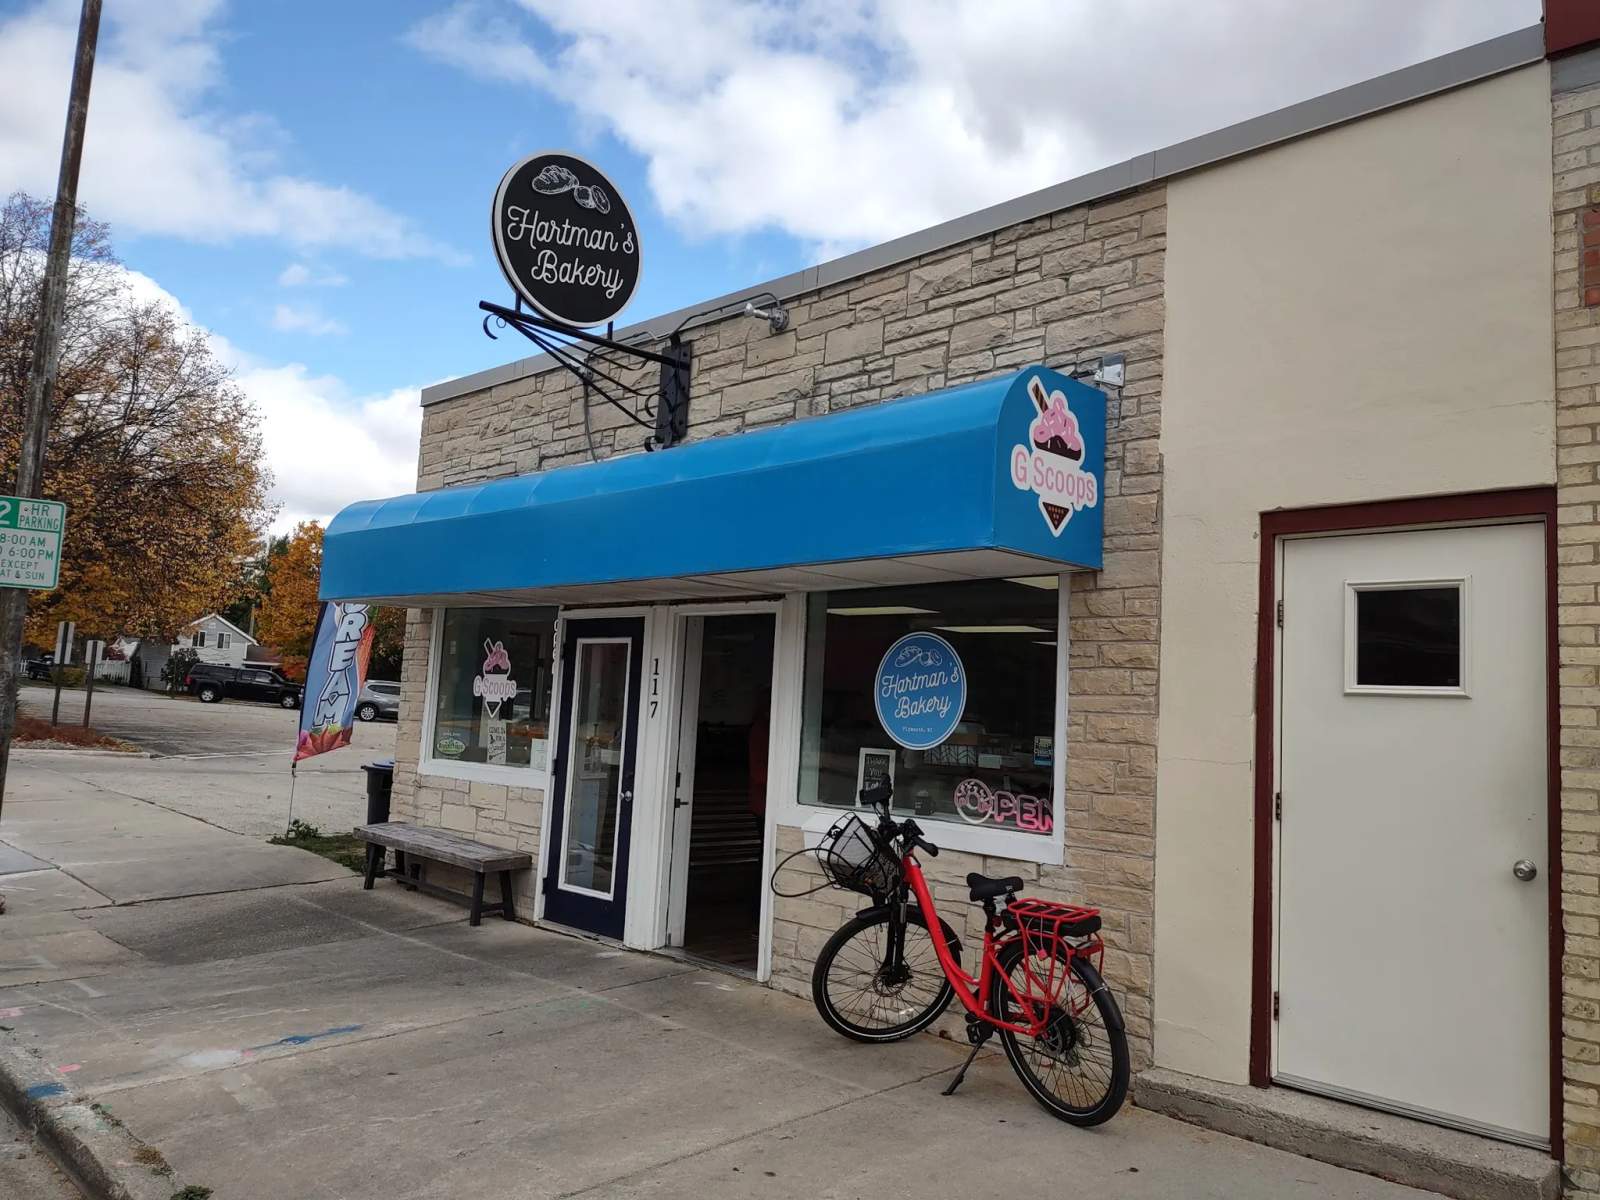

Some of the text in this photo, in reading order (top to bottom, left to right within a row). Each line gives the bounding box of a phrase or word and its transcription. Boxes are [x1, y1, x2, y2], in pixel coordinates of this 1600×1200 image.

[507, 205, 634, 254] Hartman's
[531, 249, 624, 299] Bakery
[1014, 451, 1095, 504] G Scoops
[31, 503, 50, 517] HR
[19, 515, 60, 530] PARKING
[29, 536, 46, 547] AM
[8, 546, 36, 559] 6:00
[37, 549, 54, 561] PM
[0, 559, 40, 570] EXCEPT
[25, 571, 45, 580] SUN
[482, 677, 516, 700] Scoops
[881, 662, 960, 699] Hartman's
[894, 694, 951, 719] Bakery
